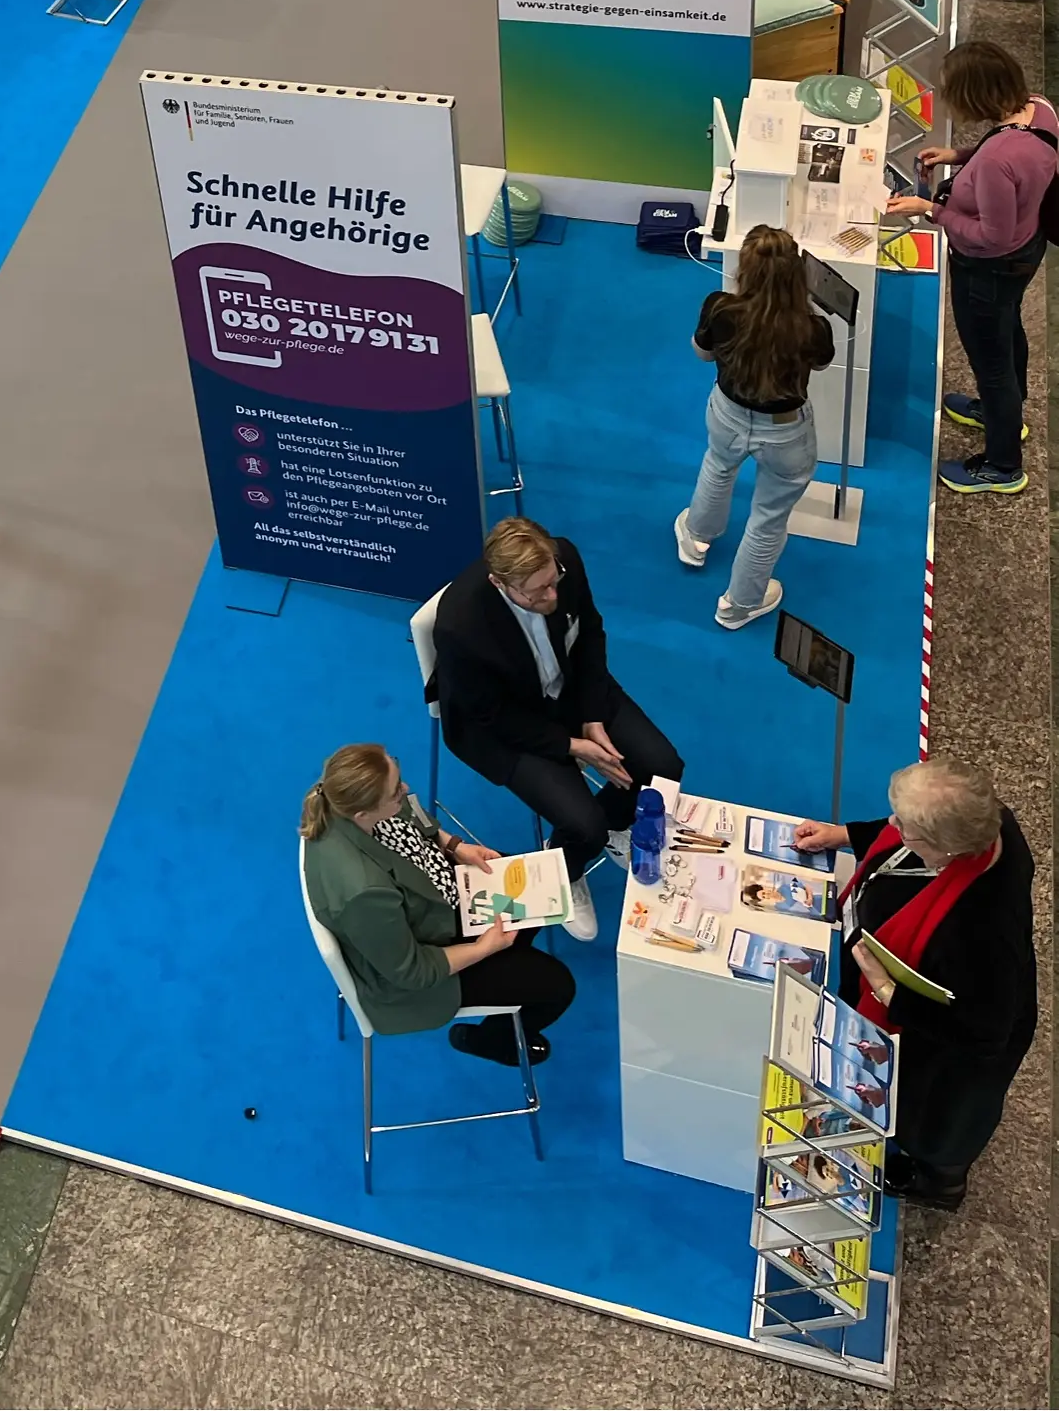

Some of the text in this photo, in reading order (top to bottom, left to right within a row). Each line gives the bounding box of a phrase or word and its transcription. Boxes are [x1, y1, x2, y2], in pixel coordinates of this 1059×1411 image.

[517, 0, 727, 22] www.strategie-gegen-einsamkeit.de
[193, 102, 261, 114] Bundesministerium
[206, 110, 233, 120] Familie,
[234, 113, 268, 124] Senioren,
[269, 117, 294, 125] Frauen
[210, 119, 236, 128] Jugend
[186, 171, 406, 219] Schnelle Hilfe
[190, 202, 430, 253] für Angehörige
[218, 289, 414, 328] PFLEGETELEFON
[221, 308, 280, 332] 030
[224, 331, 345, 355] wege-zur-pflege.de
[235, 405, 258, 417] Das
[260, 409, 339, 429] Pflegetelefon
[276, 432, 406, 459] unterstützt Sie in Ihrer
[278, 441, 400, 468] besonderen Situation
[281, 460, 432, 493] hat eine Lotsenfunktion zu
[282, 471, 447, 506] den Pflegeangeboten vor Ort
[285, 489, 424, 520] ist auch per E-Mail unter
[286, 500, 430, 532] info@wege-zur-pflege.de
[288, 512, 344, 527] erreichbar
[254, 521, 397, 554] All das selbstverständlich
[255, 533, 391, 563] anonym und vertraulich!
